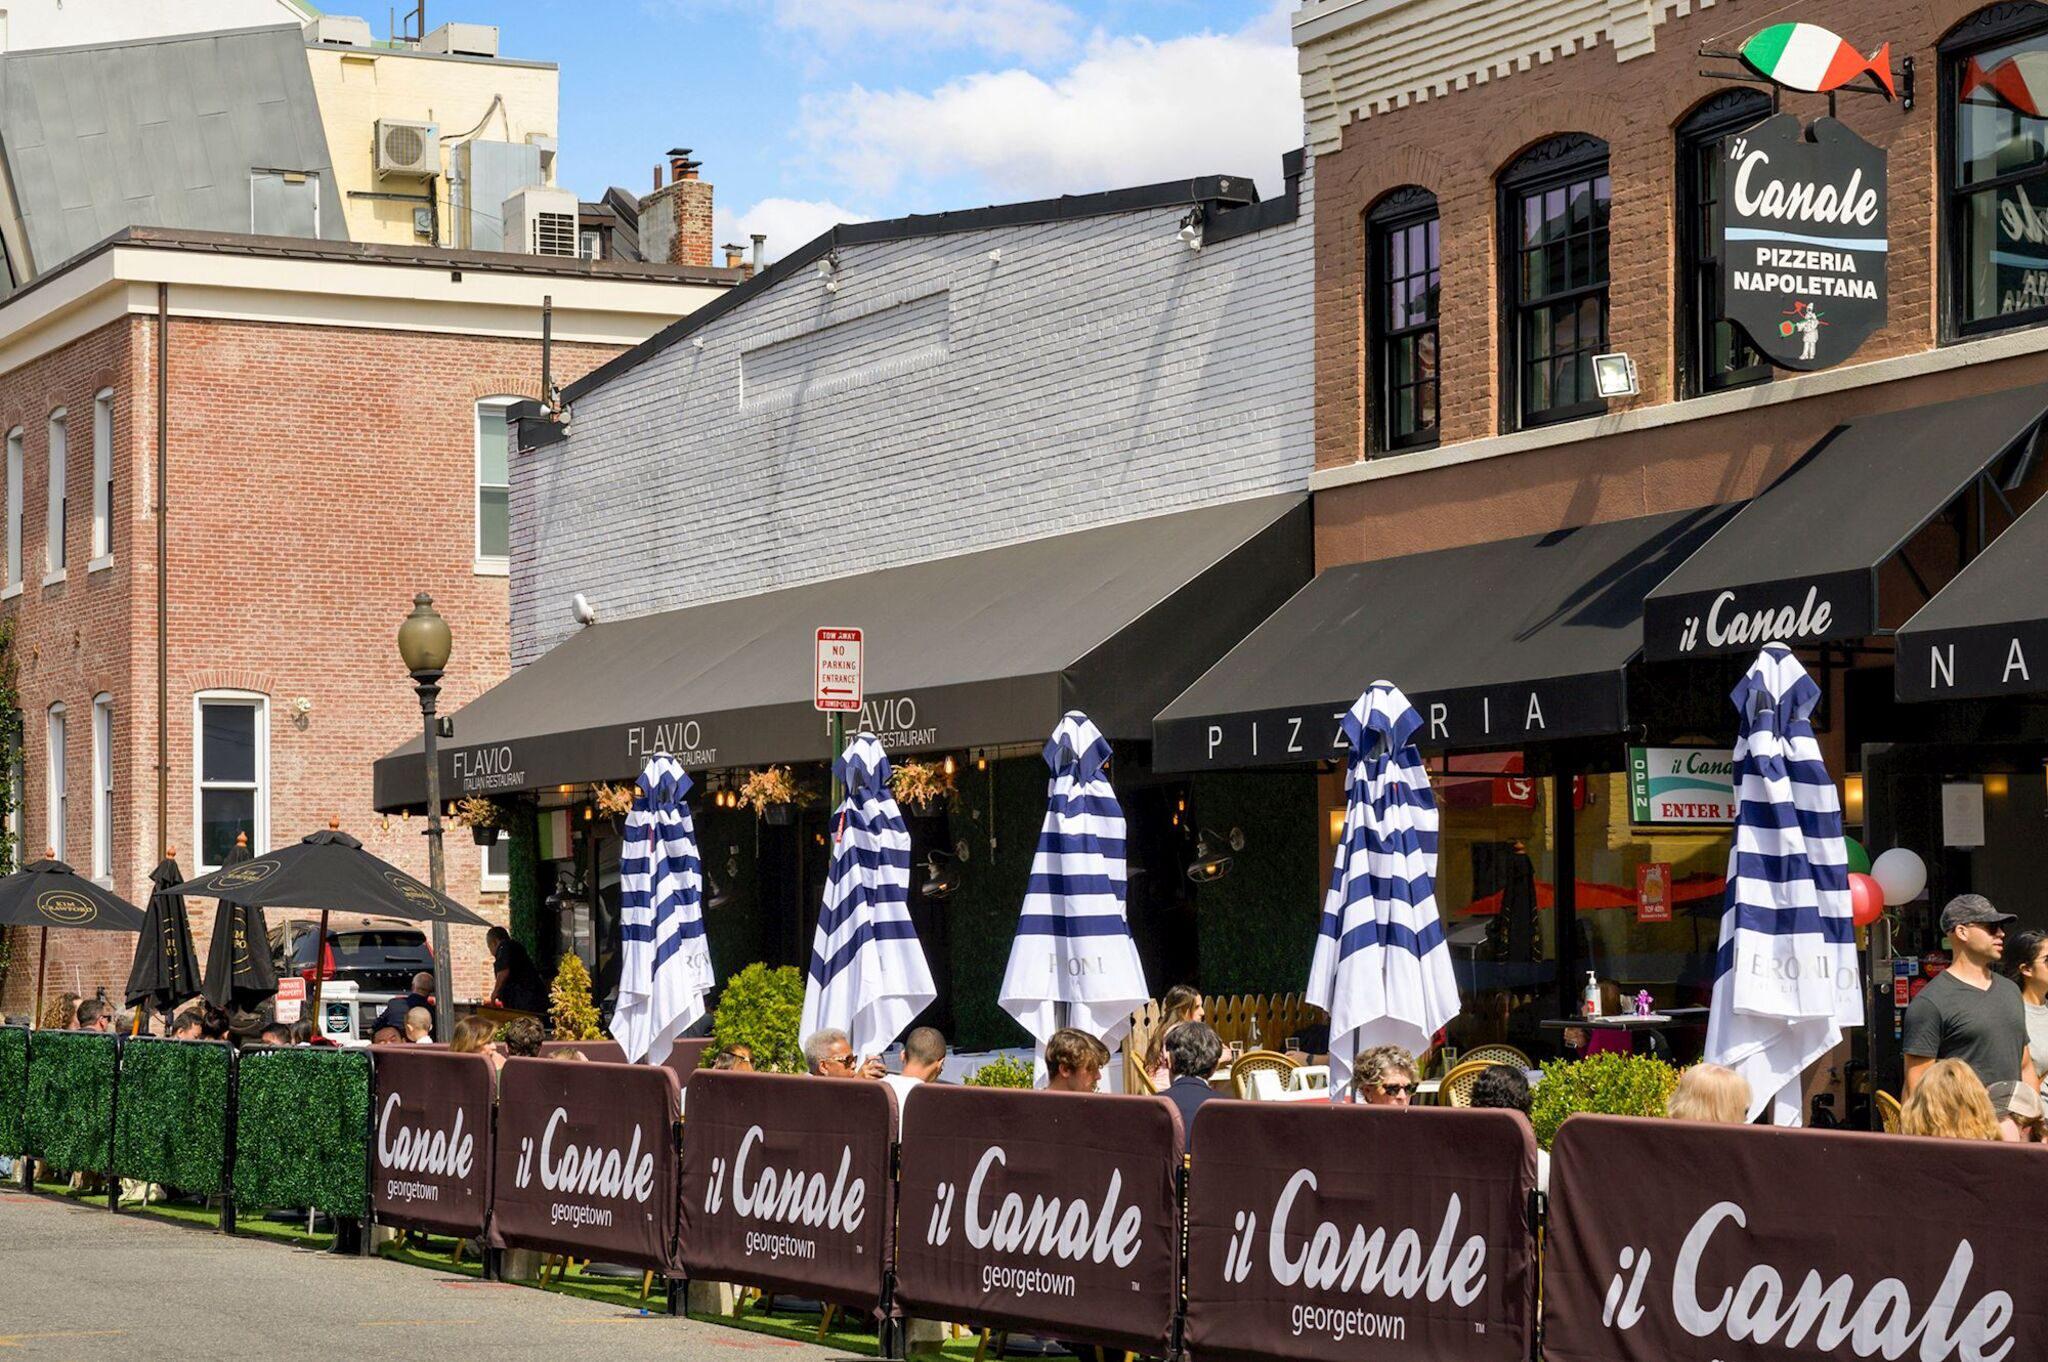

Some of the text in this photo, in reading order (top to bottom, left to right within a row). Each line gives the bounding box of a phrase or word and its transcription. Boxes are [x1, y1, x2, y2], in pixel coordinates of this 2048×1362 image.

[1730, 138, 1879, 226] il Canale
[1756, 247, 1857, 273] PIZZERIA
[1733, 271, 1878, 299] NAPOLETANA
[1679, 585, 1833, 652] il Canale
[822, 631, 857, 640] TOW AWAY
[832, 645, 845, 657] NO
[822, 660, 857, 670] PARKING
[822, 673, 856, 684] ENTRANCE
[628, 720, 700, 757] FLAVIO
[1208, 692, 1547, 759] PIZZRIA
[453, 746, 513, 779] FLAVIO
[486, 770, 525, 788] RESTAURANT
[1671, 752, 1733, 775] il Cana
[1634, 760, 1648, 807] OPEN
[1661, 803, 1720, 818] ENTER
[378, 1092, 474, 1179] Canale
[515, 1106, 655, 1203] il Canale
[387, 1179, 439, 1202] georgetown
[704, 1125, 866, 1233] il Canale
[551, 1201, 613, 1228] georgetown
[927, 1145, 1142, 1268] il Canale
[745, 1231, 816, 1260] georgetown
[1223, 1168, 1487, 1308] il Canale
[982, 1264, 1076, 1298] georgetown
[1602, 1201, 2016, 1362] il Canale
[1291, 1304, 1406, 1341] georgetown
